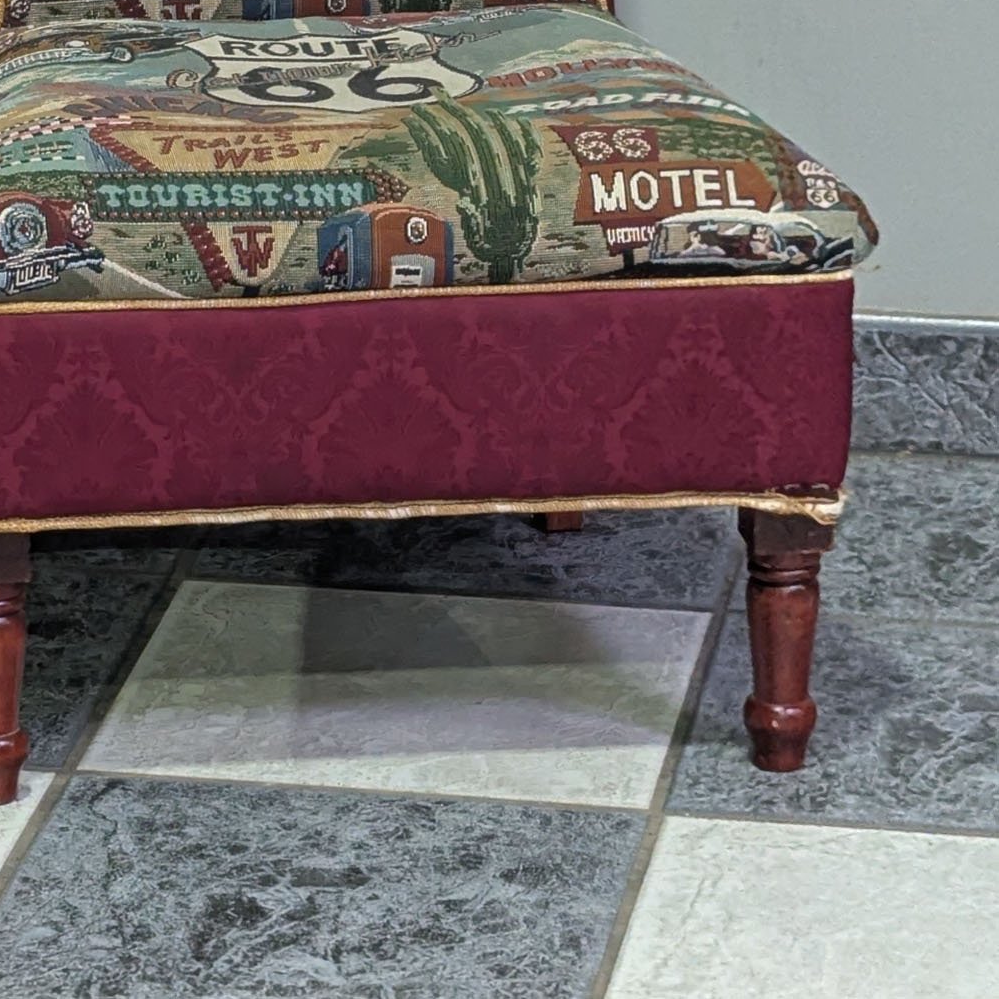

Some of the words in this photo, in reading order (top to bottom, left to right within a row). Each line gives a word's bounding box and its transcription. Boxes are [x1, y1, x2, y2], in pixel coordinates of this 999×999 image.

[219, 36, 401, 59] ROUTE
[237, 65, 443, 103] 66
[504, 92, 634, 115] ROAD
[152, 128, 294, 155] TRAILS
[214, 139, 330, 170] WEST
[574, 127, 652, 161] 66
[590, 168, 756, 213] MOTEL
